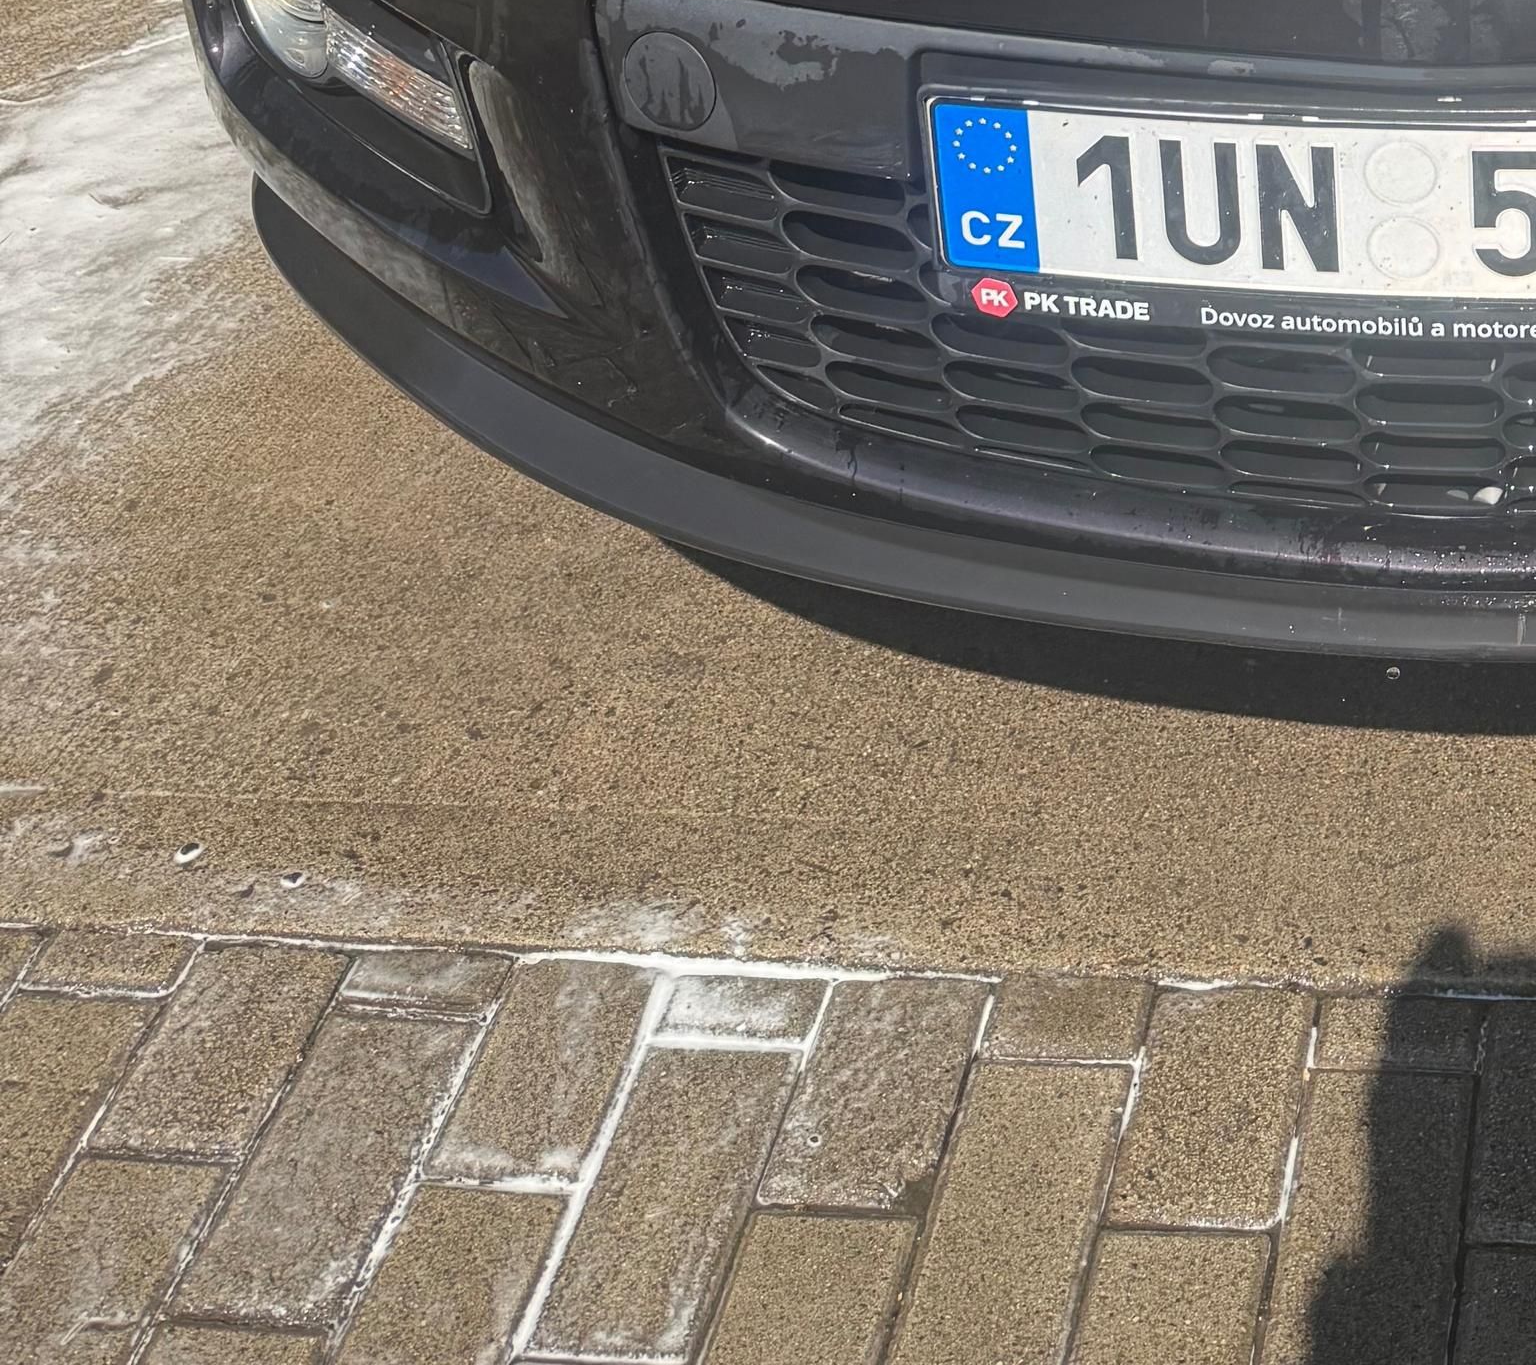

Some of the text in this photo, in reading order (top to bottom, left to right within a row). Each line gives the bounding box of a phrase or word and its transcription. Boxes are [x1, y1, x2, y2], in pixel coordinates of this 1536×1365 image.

[1073, 135, 1341, 274] 1UN
[959, 209, 1027, 250] CZ
[978, 287, 1011, 308] PK
[1023, 291, 1151, 321] PK TRADE
[1200, 306, 1276, 330] Dovoz
[1280, 314, 1424, 339] automobilů
[1430, 323, 1446, 339] a
